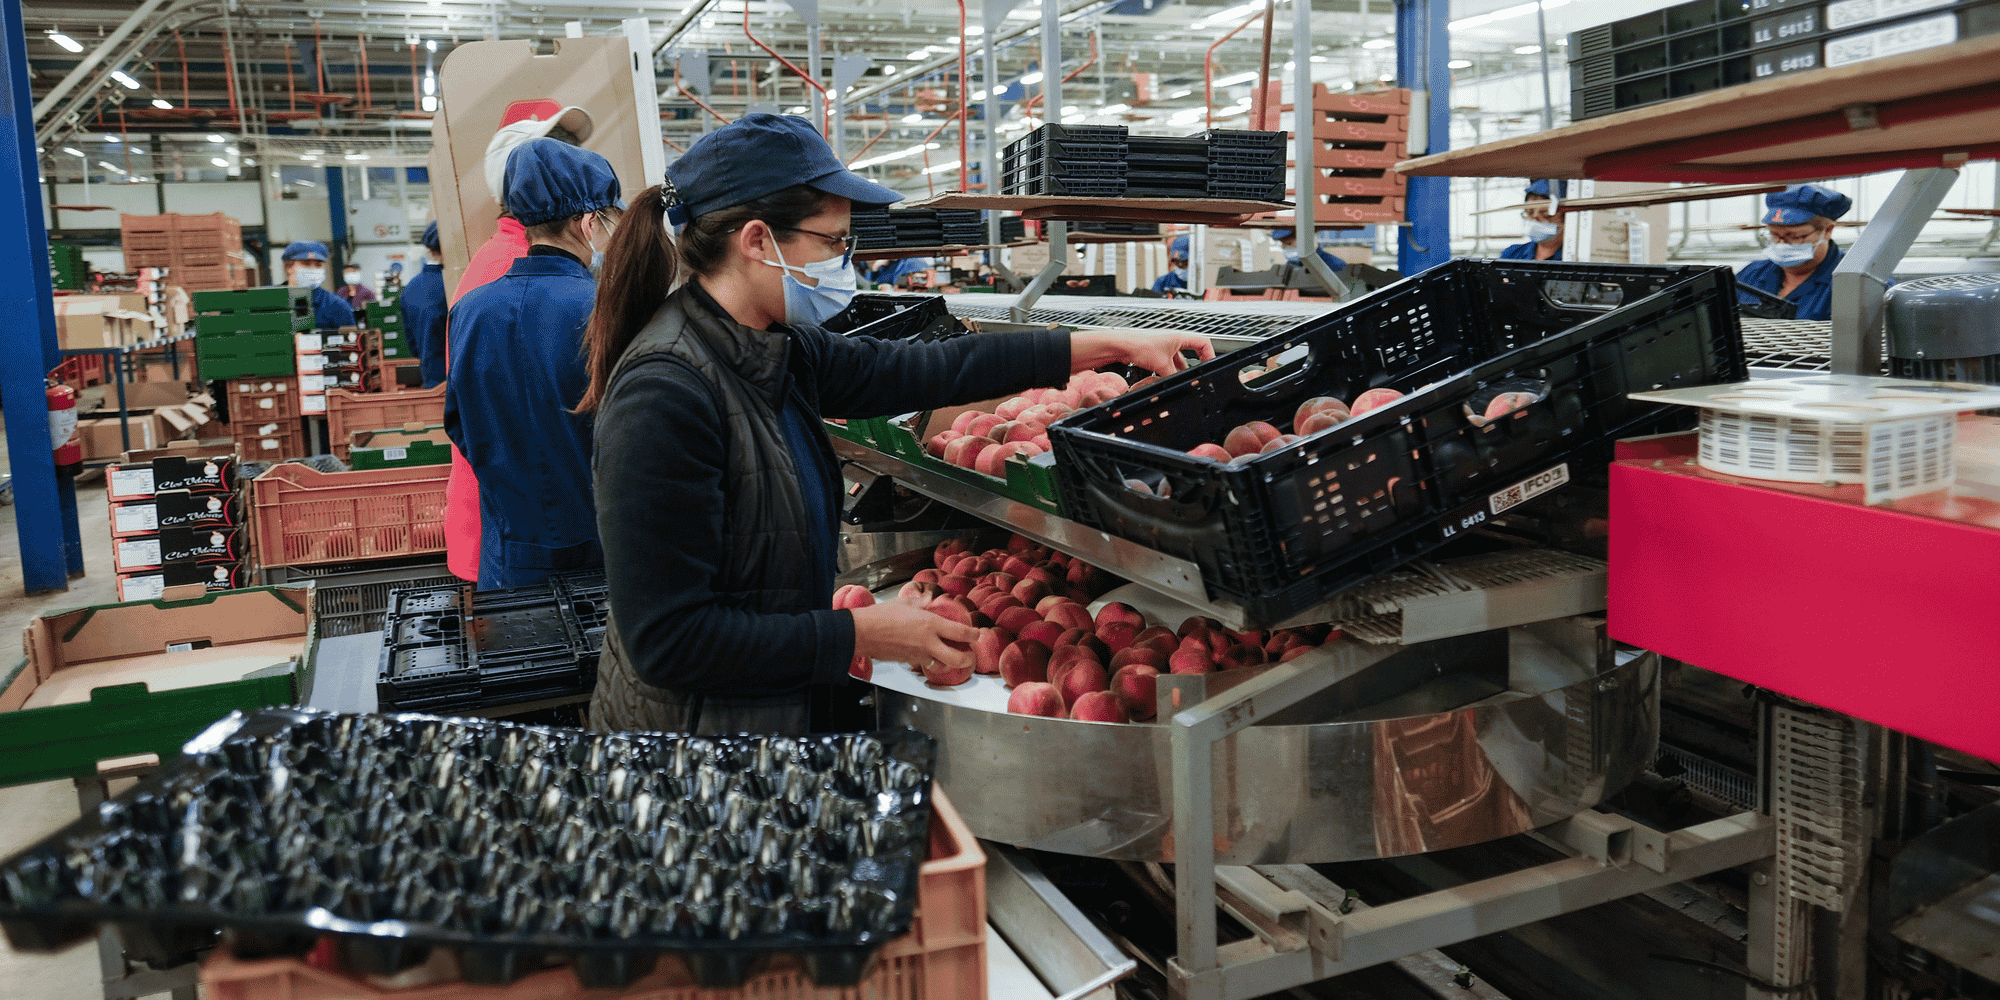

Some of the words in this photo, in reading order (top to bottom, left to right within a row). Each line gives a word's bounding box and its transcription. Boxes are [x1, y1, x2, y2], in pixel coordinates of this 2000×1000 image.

[1754, 29, 1773, 43] LL
[1778, 19, 1814, 38] 6413
[1756, 63, 1774, 77] LL
[1780, 54, 1815, 72] 6413
[1523, 473, 1551, 493] IFCO
[1442, 525, 1457, 537] LL
[1461, 511, 1486, 529] 6413
